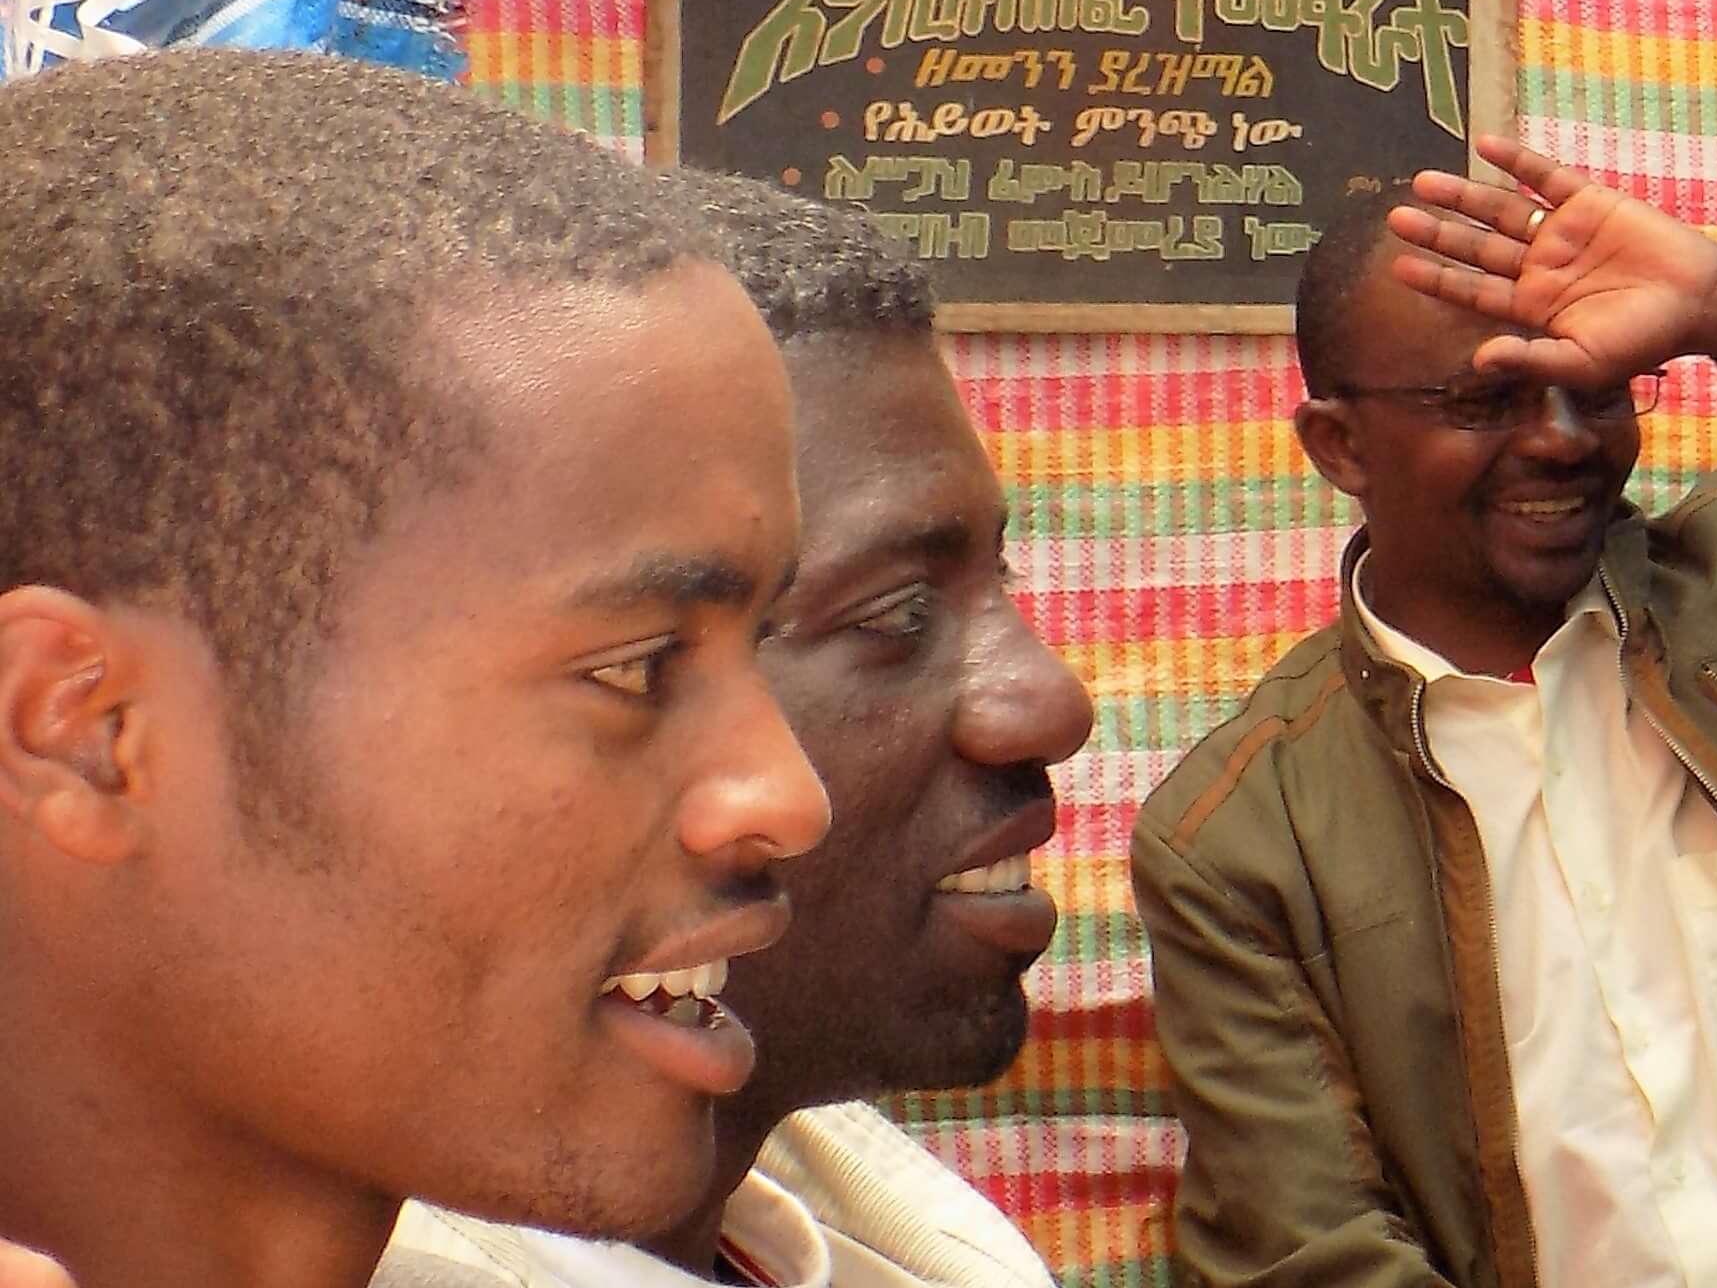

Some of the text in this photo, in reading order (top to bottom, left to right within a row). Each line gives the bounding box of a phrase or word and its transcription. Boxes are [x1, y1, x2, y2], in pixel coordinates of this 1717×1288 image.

[915, 47, 1276, 98] ዘመንን ያረዝማል
[1069, 107, 1218, 150] ምንጭ
[1230, 111, 1304, 151] ነው
[1243, 215, 1324, 261] ነው
